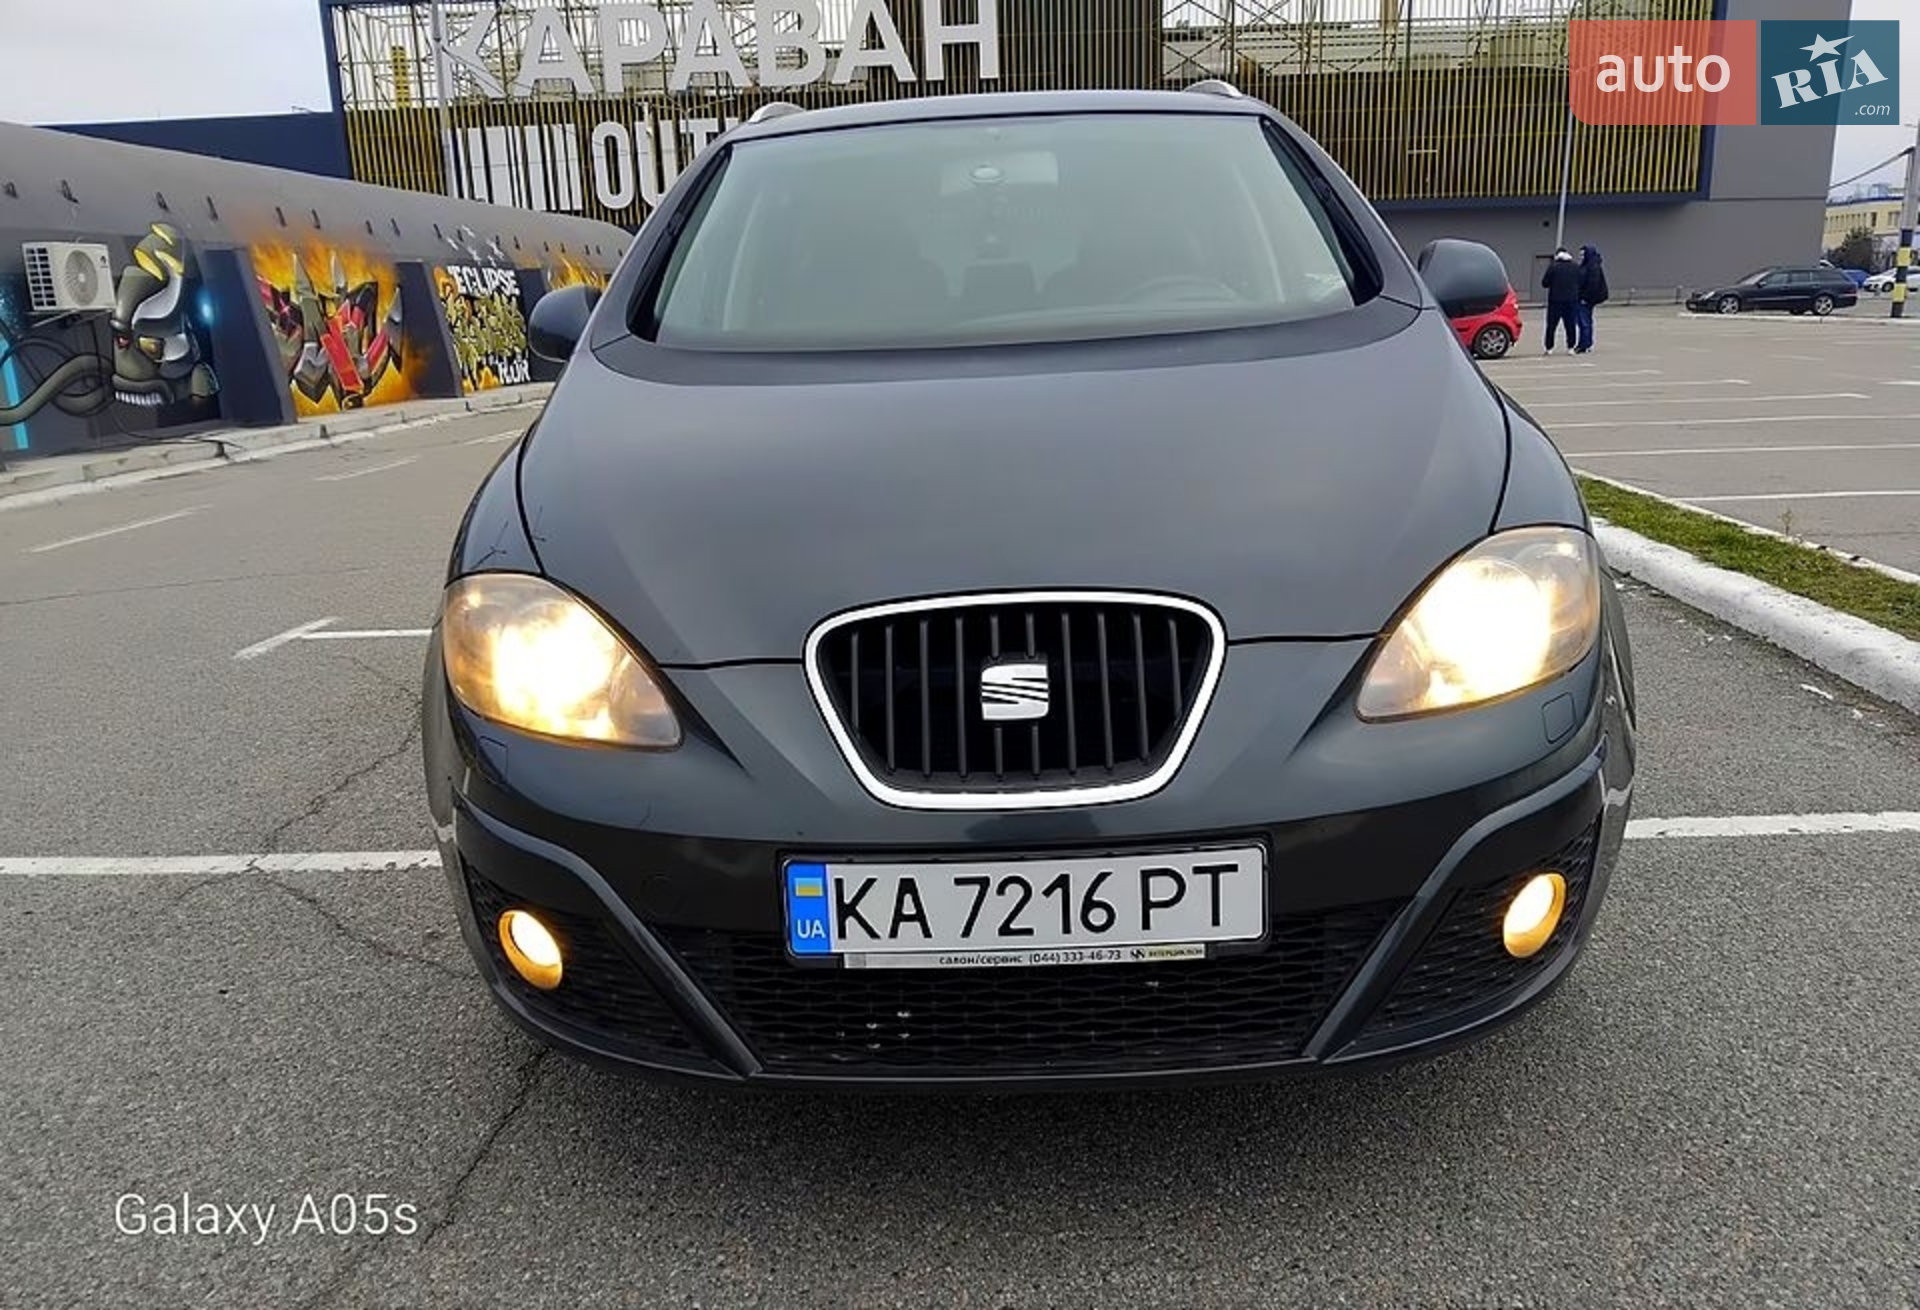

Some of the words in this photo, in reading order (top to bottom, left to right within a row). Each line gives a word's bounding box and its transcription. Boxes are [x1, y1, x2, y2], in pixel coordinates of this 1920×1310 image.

[797, 919, 826, 939] UA
[833, 877, 932, 941] KA
[953, 871, 1117, 939] 7216
[1140, 864, 1239, 931] PT
